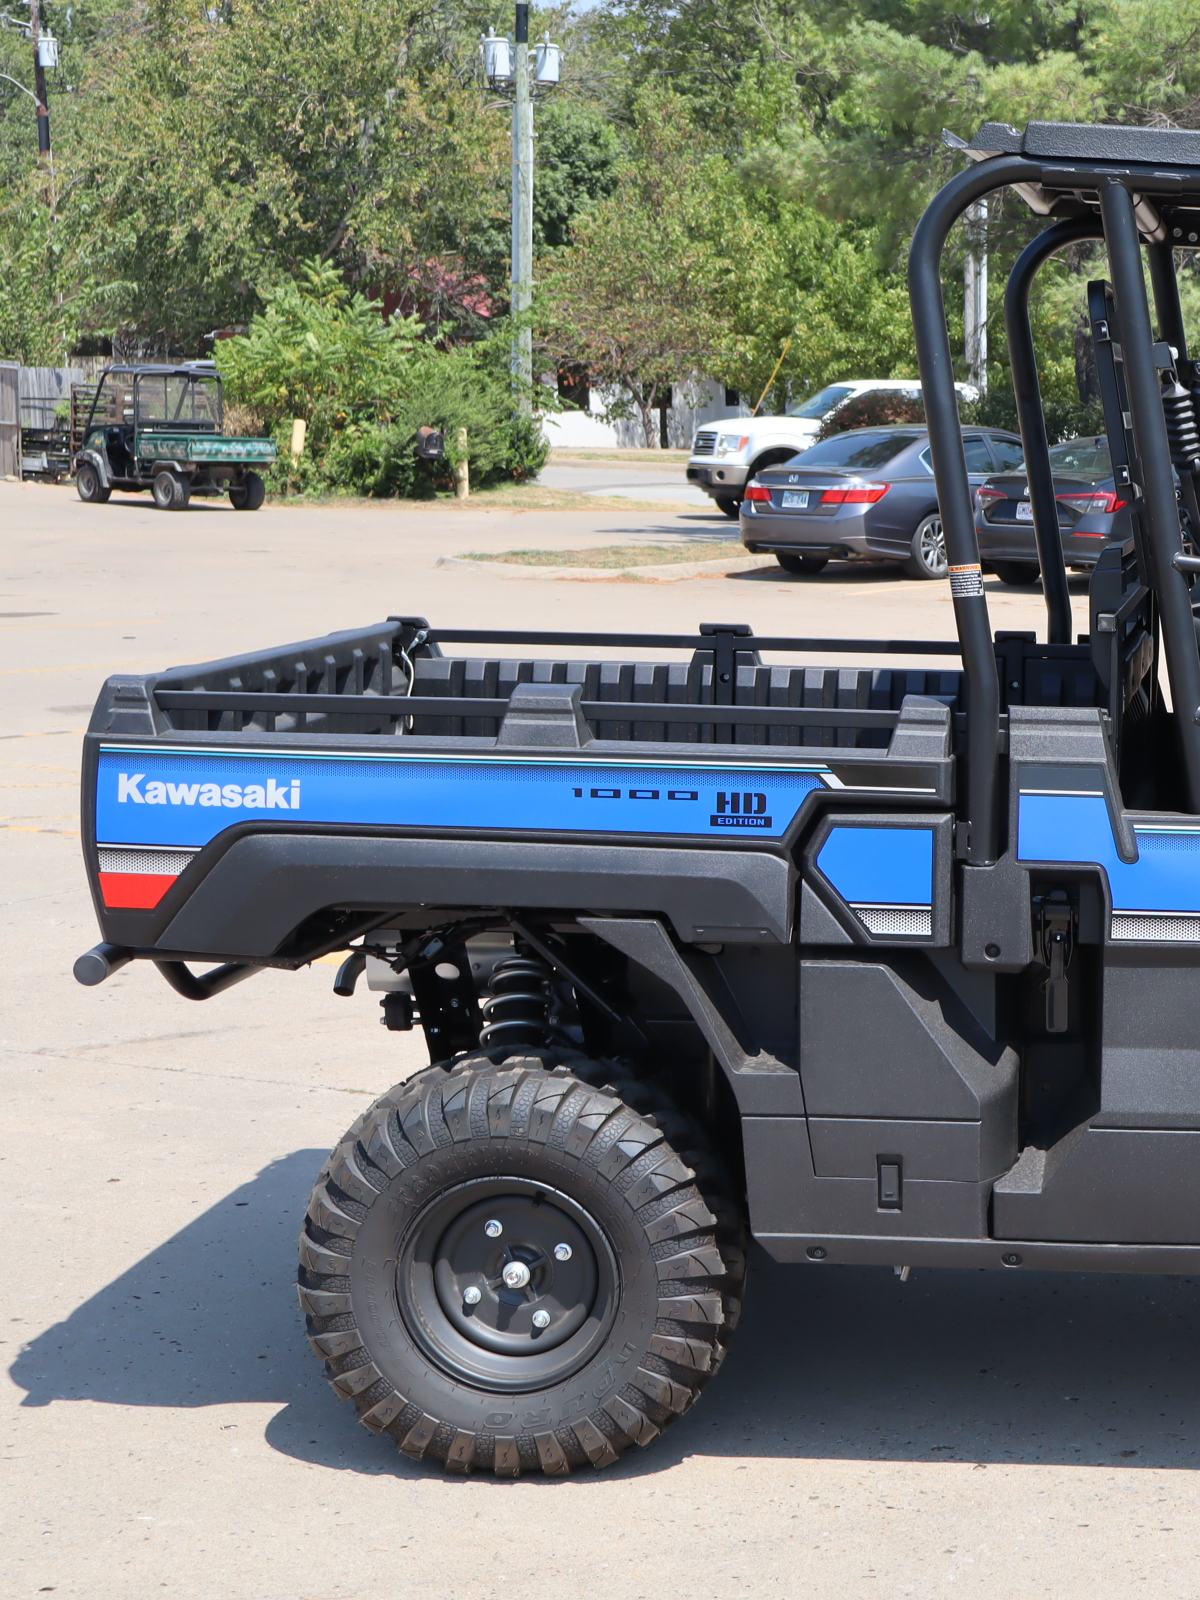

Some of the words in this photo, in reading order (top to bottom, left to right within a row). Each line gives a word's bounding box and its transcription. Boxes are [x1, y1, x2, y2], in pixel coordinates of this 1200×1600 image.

[118, 773, 301, 809] Kawasaki
[572, 788, 699, 801] 1000
[716, 791, 767, 815] HD
[717, 817, 765, 826] EDITION
[483, 1368, 617, 1430] DURO
